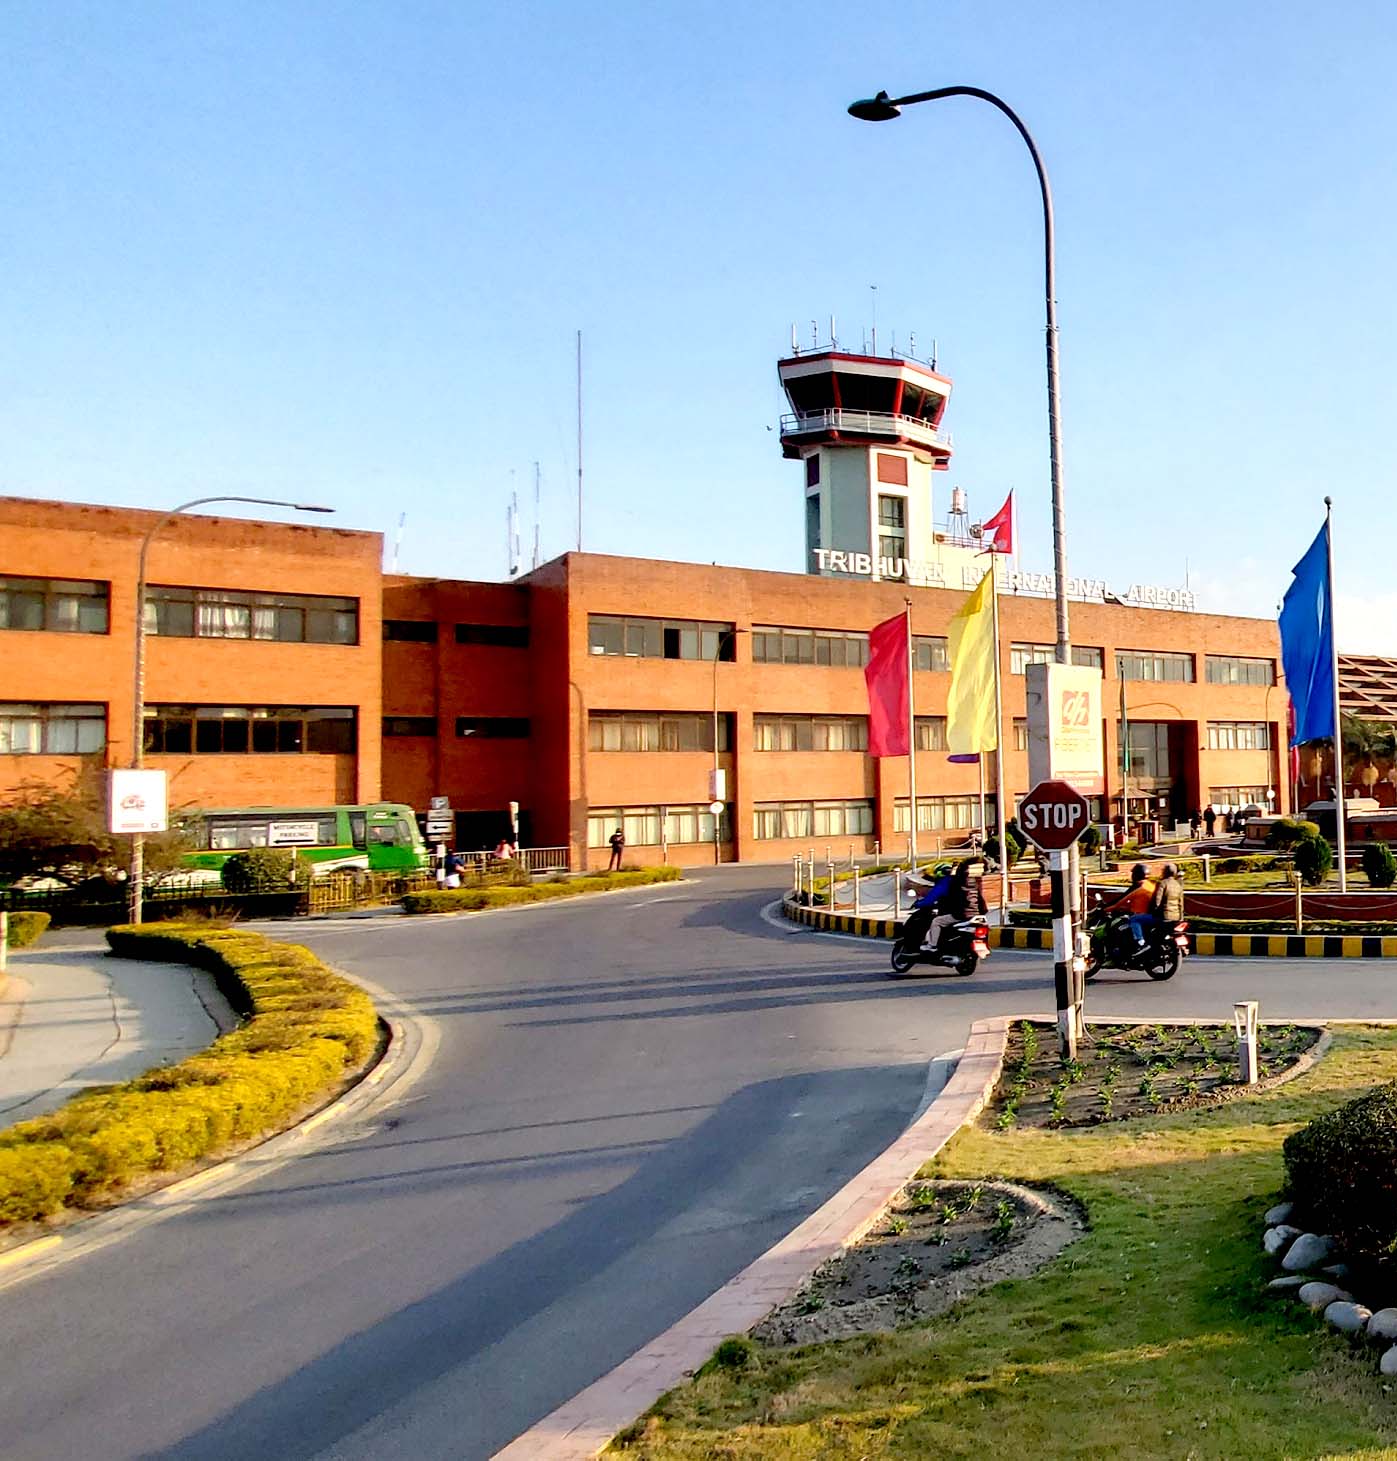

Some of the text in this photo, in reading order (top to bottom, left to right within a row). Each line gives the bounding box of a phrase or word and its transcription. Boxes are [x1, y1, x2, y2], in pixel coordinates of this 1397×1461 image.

[962, 566, 1115, 599] INERNATONAL
[1127, 583, 1200, 608] AIRPORT
[1024, 803, 1082, 829] STOP
